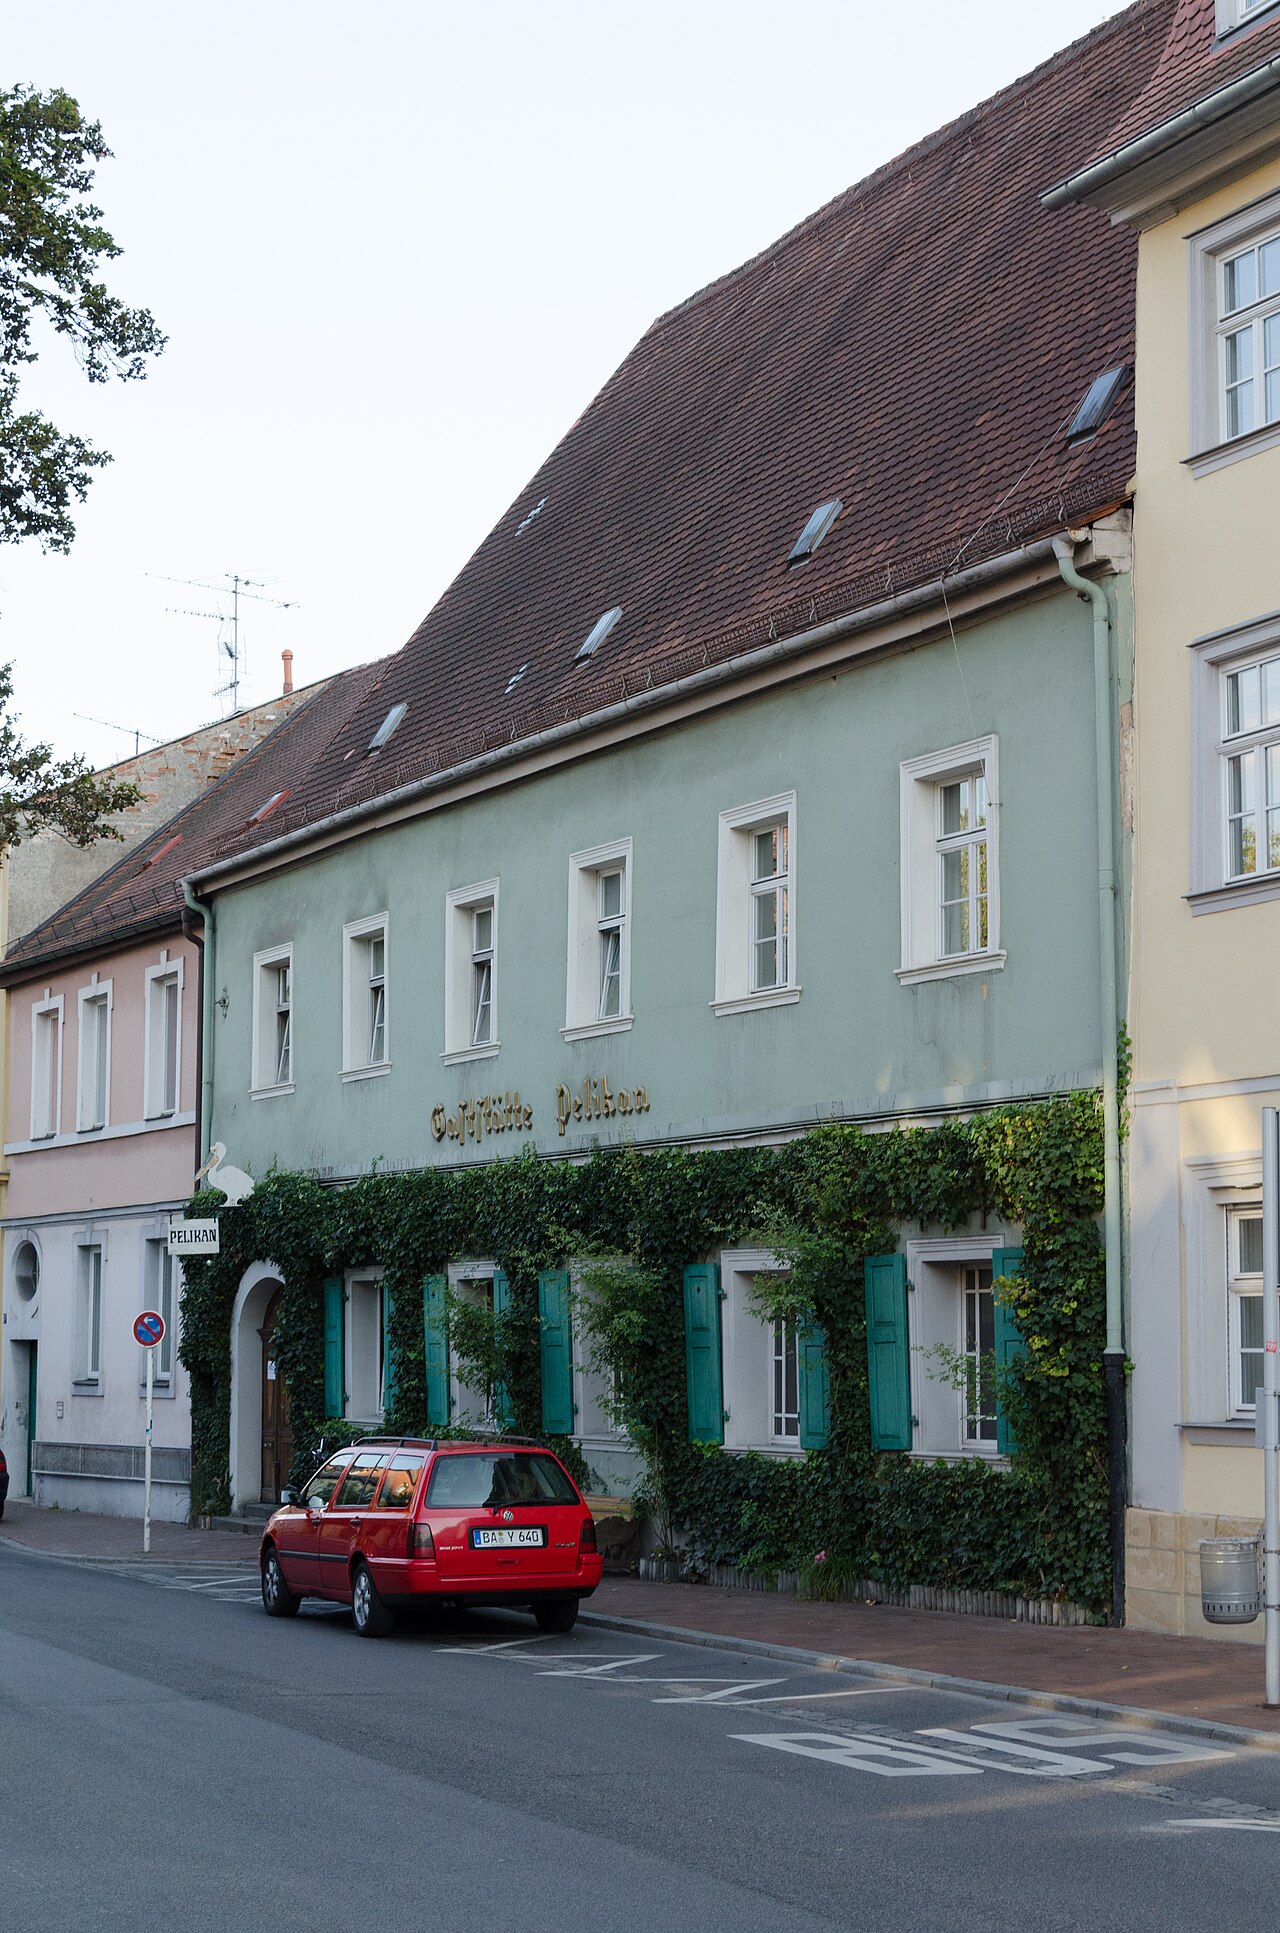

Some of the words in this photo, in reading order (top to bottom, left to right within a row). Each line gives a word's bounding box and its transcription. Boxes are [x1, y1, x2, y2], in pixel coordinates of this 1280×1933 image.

[555, 1073, 651, 1137] Pelikan
[170, 1229, 217, 1244] PELIKAN
[482, 1532, 498, 1544] BA
[507, 1531, 514, 1543] Y
[518, 1530, 539, 1543] 640
[725, 1717, 1238, 1777] BUS
